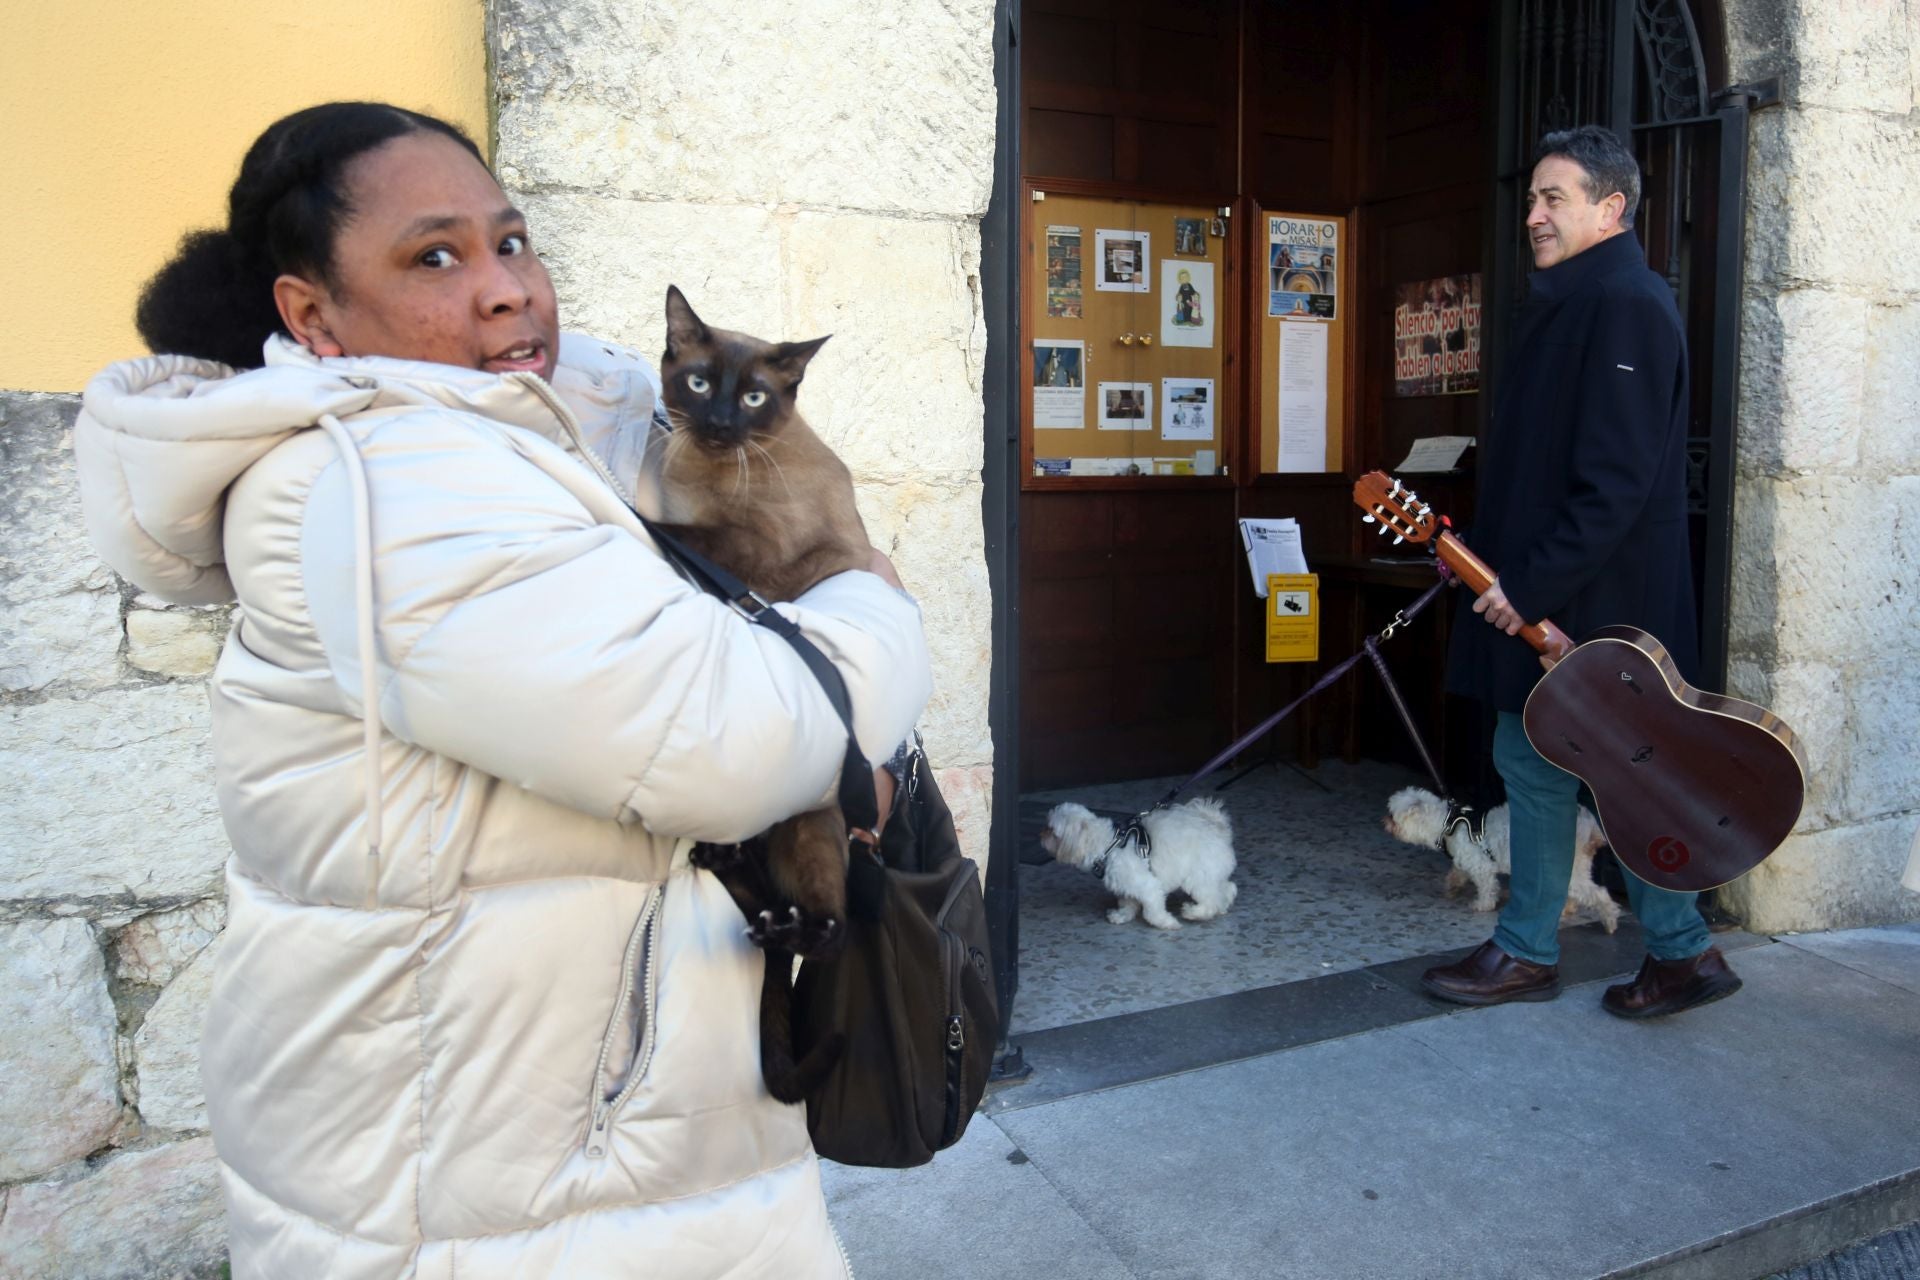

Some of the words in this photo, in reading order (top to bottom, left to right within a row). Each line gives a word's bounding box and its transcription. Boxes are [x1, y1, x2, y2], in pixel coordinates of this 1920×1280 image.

[1271, 220, 1334, 239] HORARIO
[1289, 235, 1317, 247] MISAS
[1441, 308, 1462, 338] por
[1396, 347, 1431, 380] hablen
[1433, 353, 1442, 375] a
[1442, 341, 1455, 374] la
